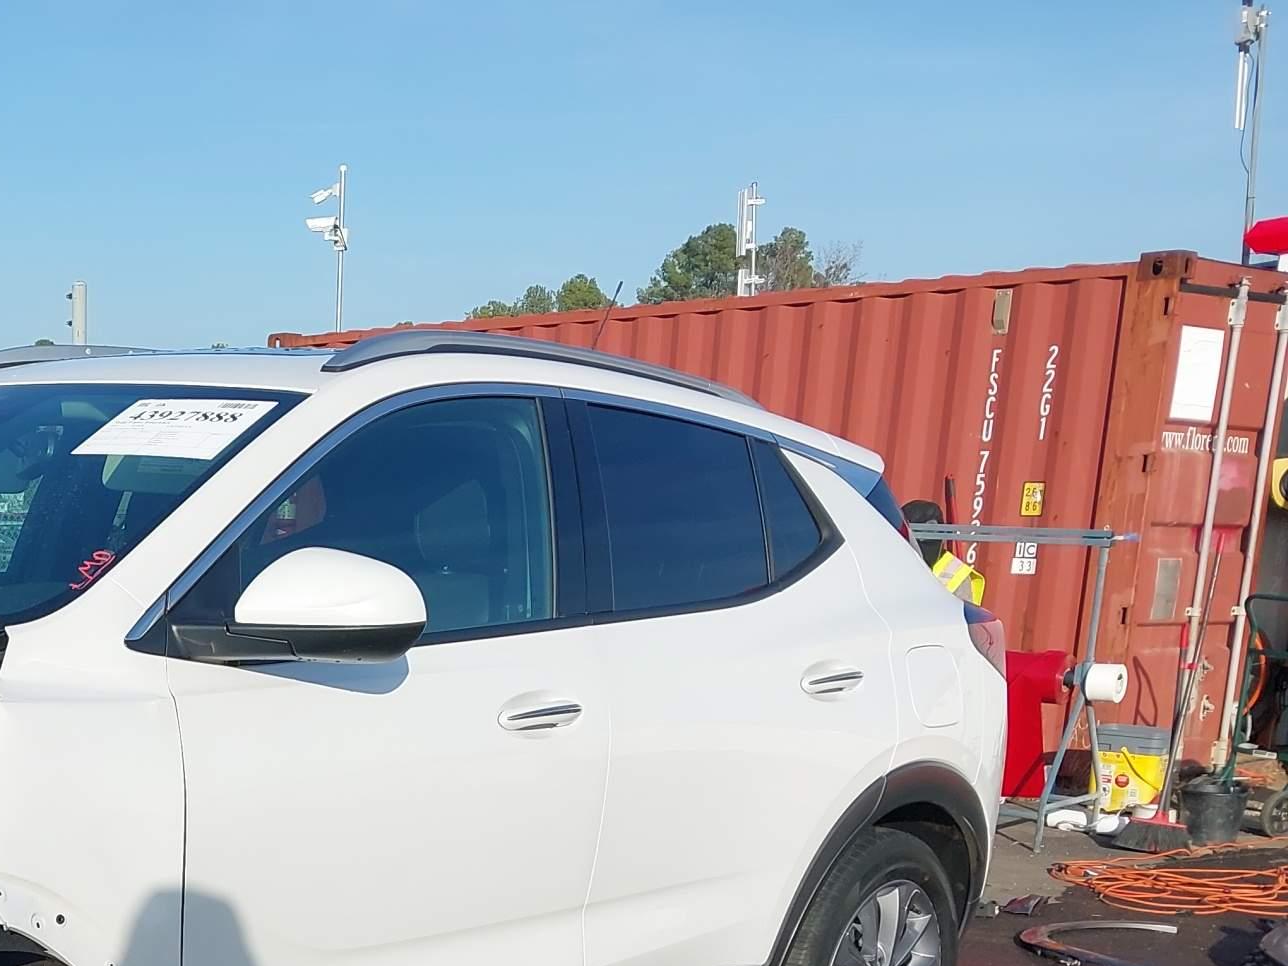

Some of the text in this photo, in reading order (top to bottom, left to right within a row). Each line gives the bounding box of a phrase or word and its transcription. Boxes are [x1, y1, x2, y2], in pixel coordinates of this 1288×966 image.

[129, 410, 243, 423] 43927888
[981, 348, 1002, 442] FSCU
[1038, 345, 1059, 440] 22G1
